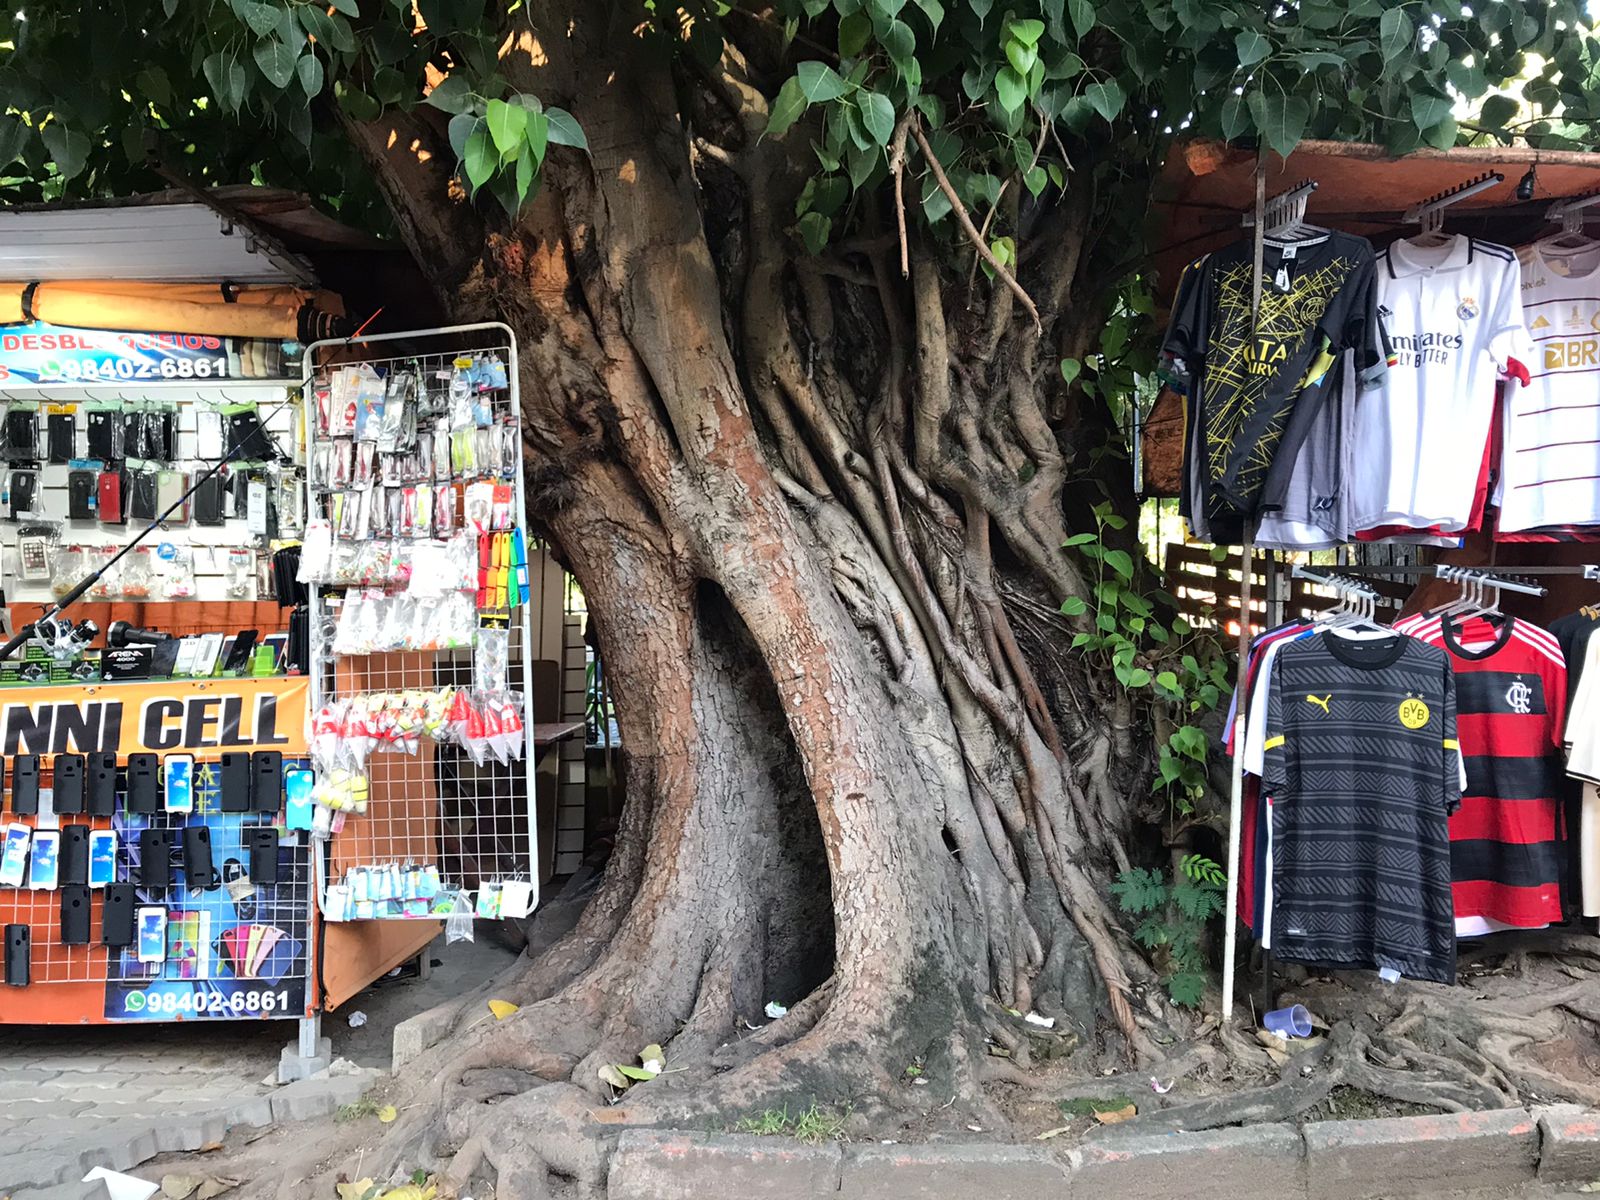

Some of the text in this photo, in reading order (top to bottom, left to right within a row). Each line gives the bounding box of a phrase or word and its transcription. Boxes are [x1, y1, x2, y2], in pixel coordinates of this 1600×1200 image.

[3, 333, 221, 350] DESBLQUEIOS
[1388, 332, 1463, 351] mirates
[1567, 340, 1600, 367] BR
[62, 358, 226, 379] 98402-6861
[1403, 702, 1425, 720] BVB
[142, 695, 290, 750] CELL
[147, 990, 288, 1013] 98402-6861
